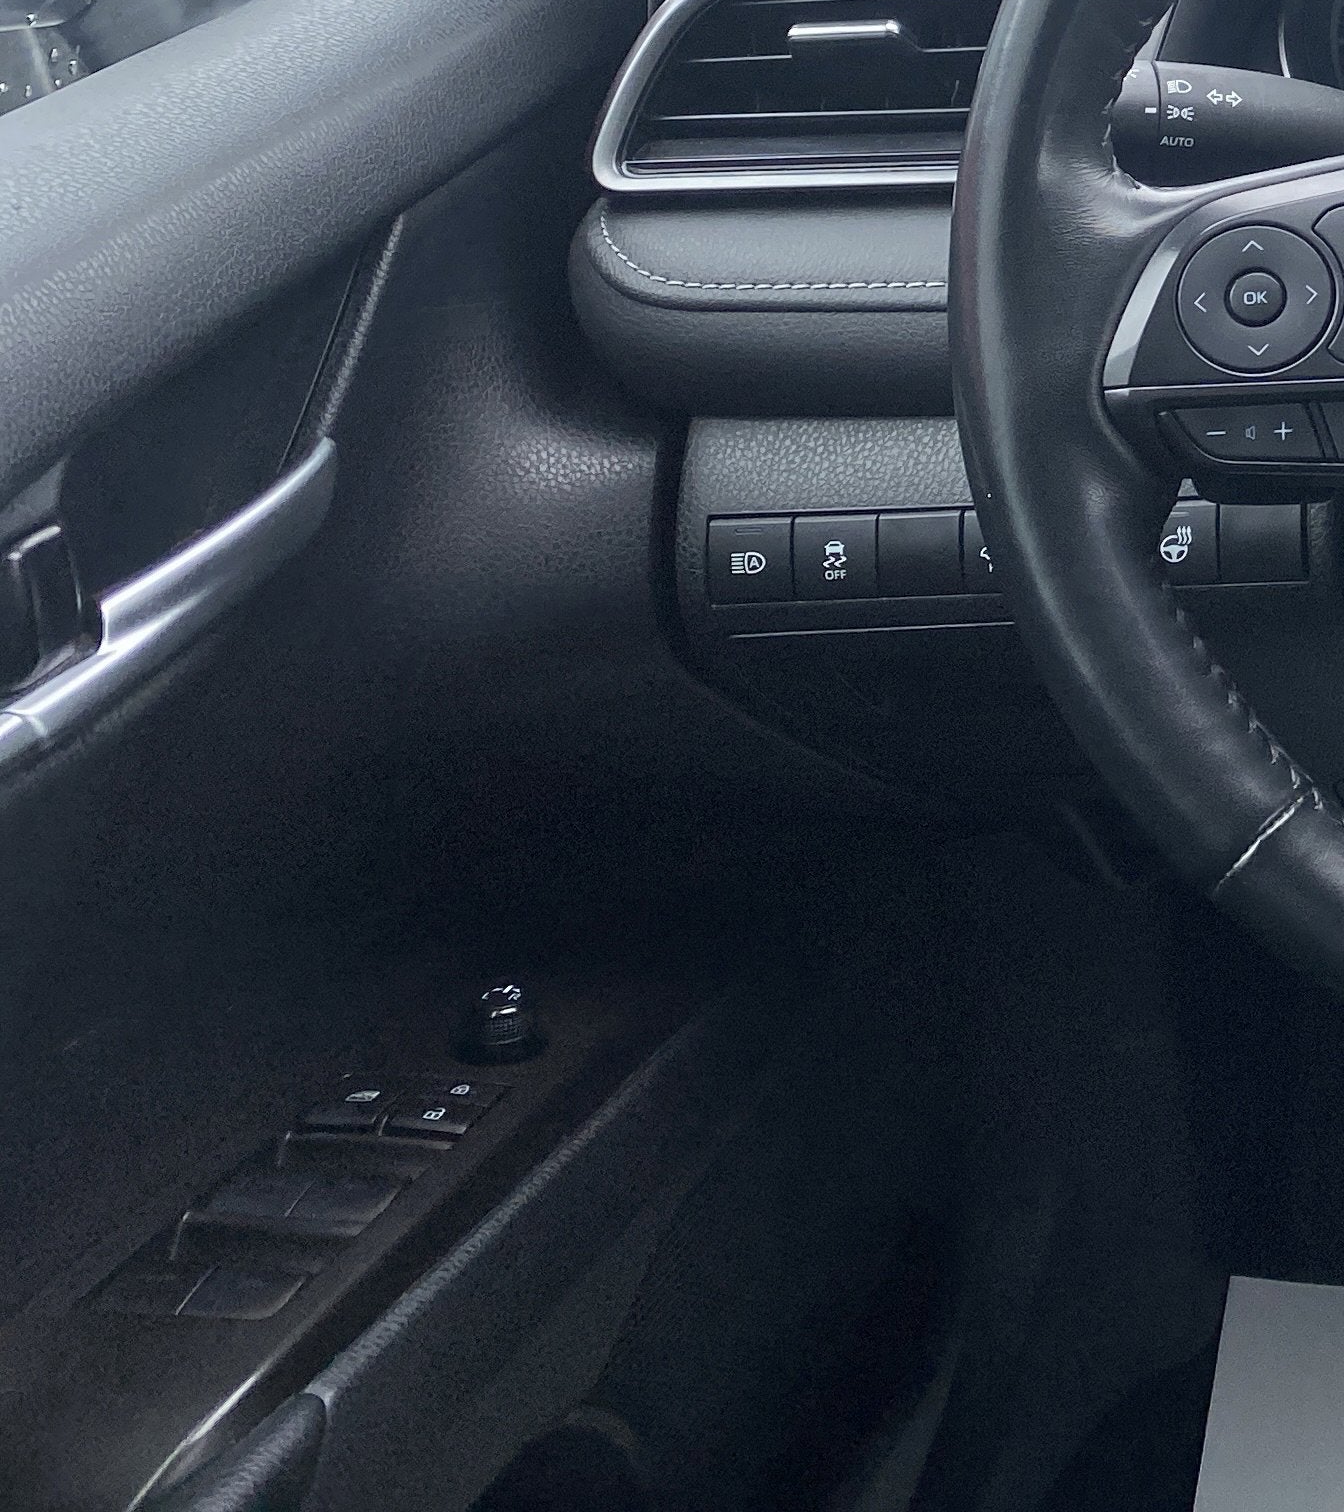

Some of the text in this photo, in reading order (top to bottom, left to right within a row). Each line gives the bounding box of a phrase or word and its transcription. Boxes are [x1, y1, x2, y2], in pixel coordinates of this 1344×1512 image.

[1160, 136, 1194, 148] AUTO
[1243, 291, 1268, 305] OK
[824, 570, 847, 580] OFF
